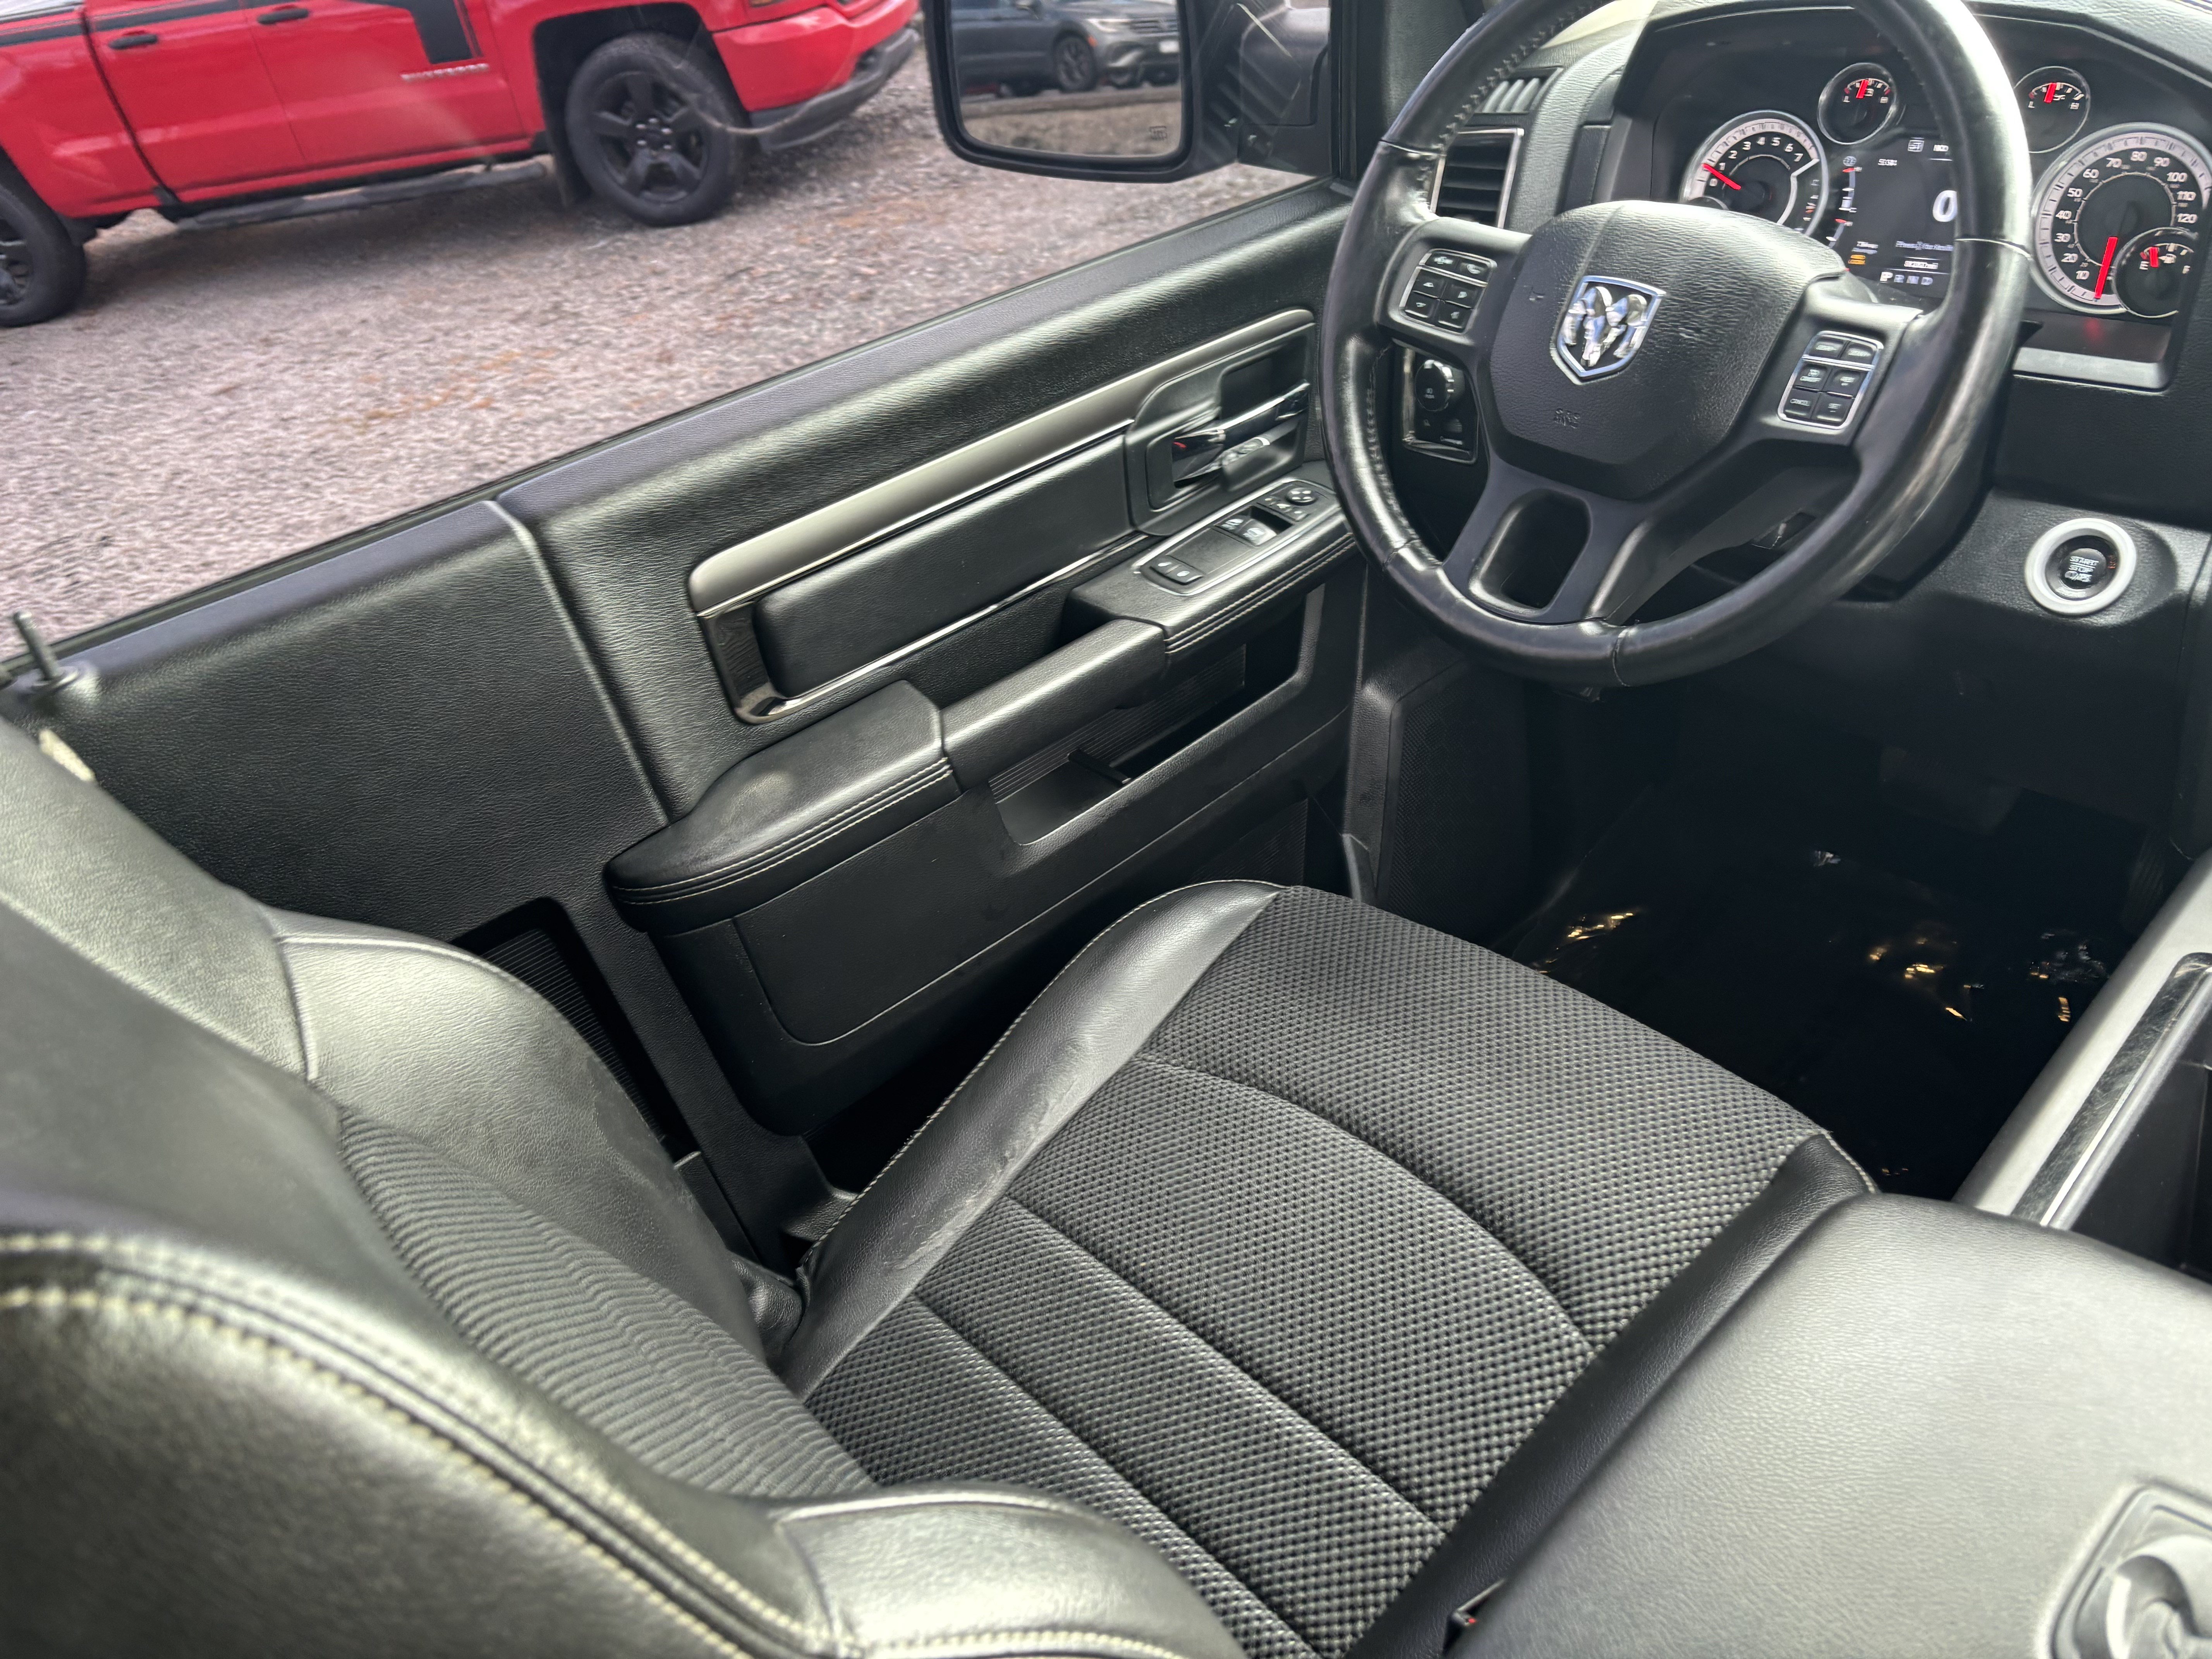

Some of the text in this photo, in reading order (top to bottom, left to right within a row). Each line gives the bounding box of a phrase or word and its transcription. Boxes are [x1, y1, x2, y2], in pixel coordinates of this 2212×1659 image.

[1743, 141, 1751, 150] 3
[1757, 137, 1765, 145] 4
[1771, 137, 1781, 146] 5
[1784, 143, 1793, 152] 6
[1728, 150, 1738, 159] 2
[1794, 153, 1803, 162] 7
[2131, 151, 2147, 161] 80
[1719, 162, 1726, 170] 1
[2106, 158, 2123, 168] 70
[2154, 157, 2170, 167] 90
[2083, 169, 2099, 179] 60
[2167, 172, 2188, 182] 100
[2067, 188, 2083, 198] 50
[2177, 191, 2197, 201] 110
[1932, 190, 1958, 222] 0
[2056, 210, 2072, 220] 40
[2177, 213, 2198, 223] 120
[2054, 233, 2071, 242] 30
[2061, 253, 2078, 263] 20
[2139, 261, 2150, 270] E
[1880, 271, 1893, 282] P
[2076, 270, 2090, 280] 10
